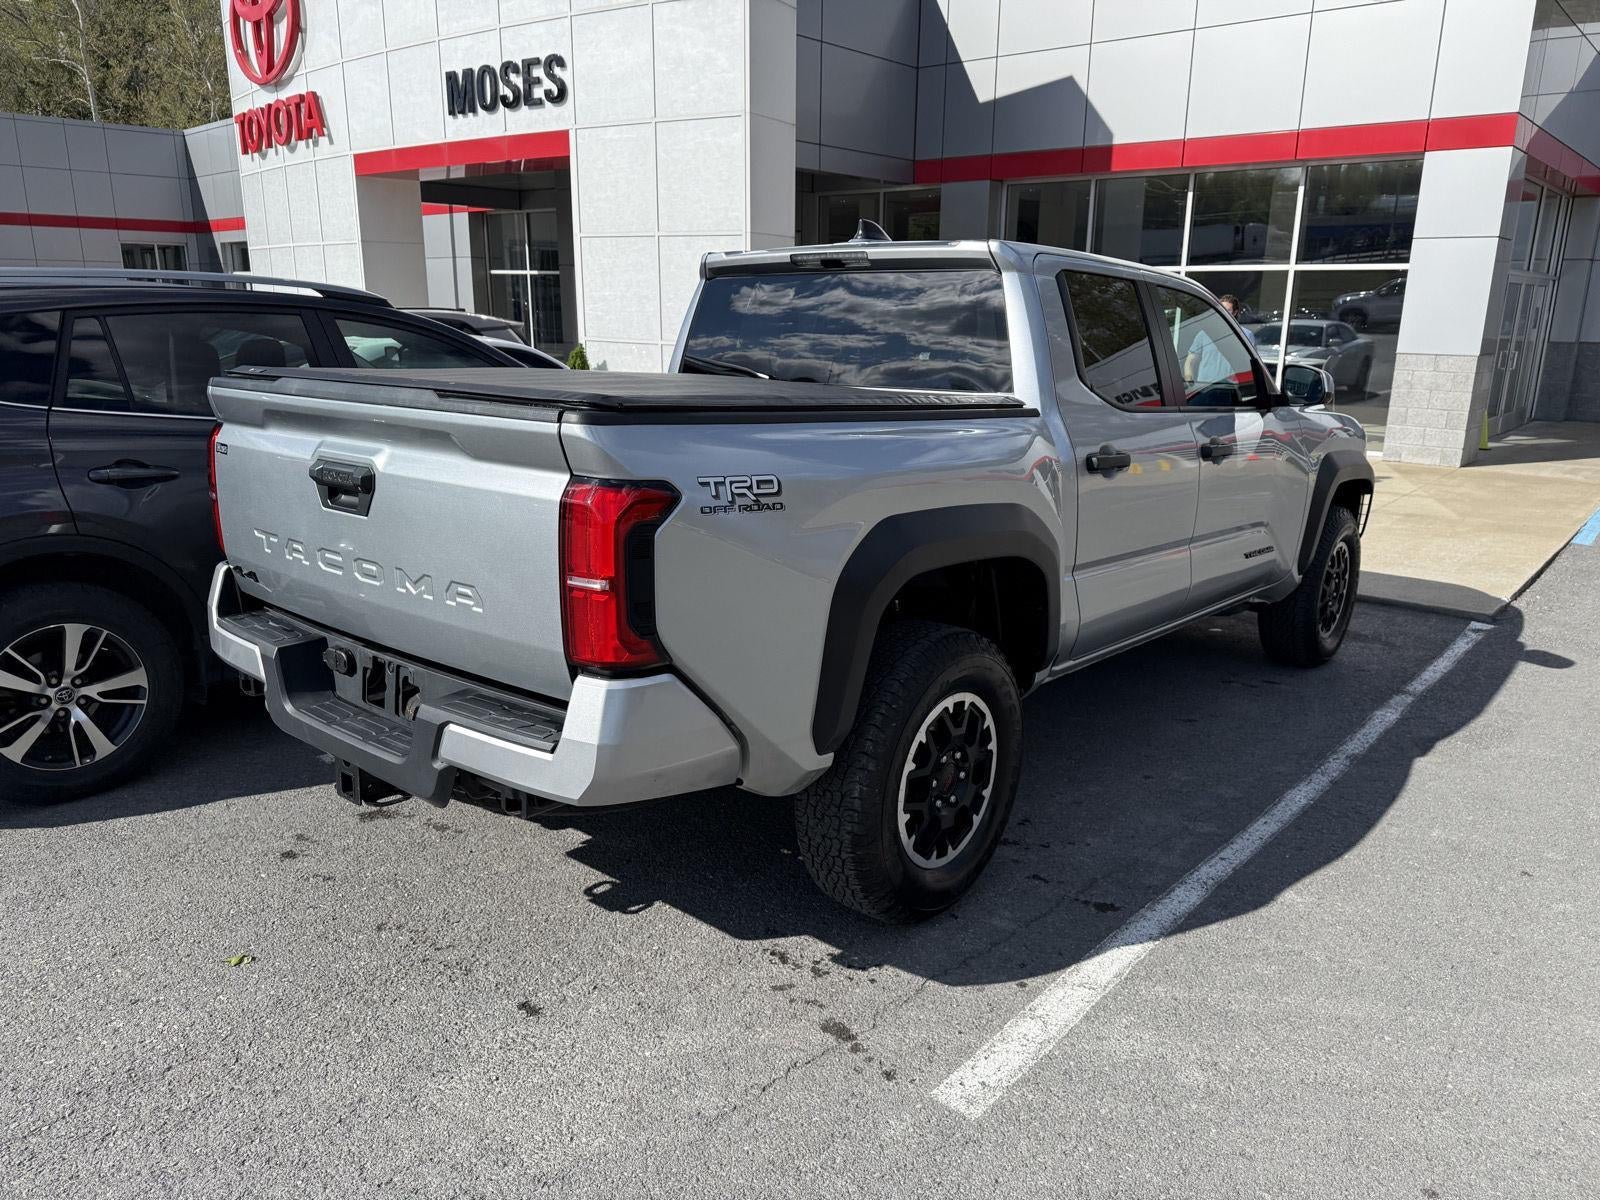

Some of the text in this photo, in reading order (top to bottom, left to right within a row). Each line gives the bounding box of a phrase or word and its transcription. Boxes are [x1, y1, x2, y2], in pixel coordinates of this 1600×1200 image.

[445, 53, 568, 117] MOSES
[234, 91, 326, 155] TOYOTA
[697, 473, 783, 504] TRD
[700, 502, 786, 515] OFF ROAD
[253, 528, 484, 613] TACOMA
